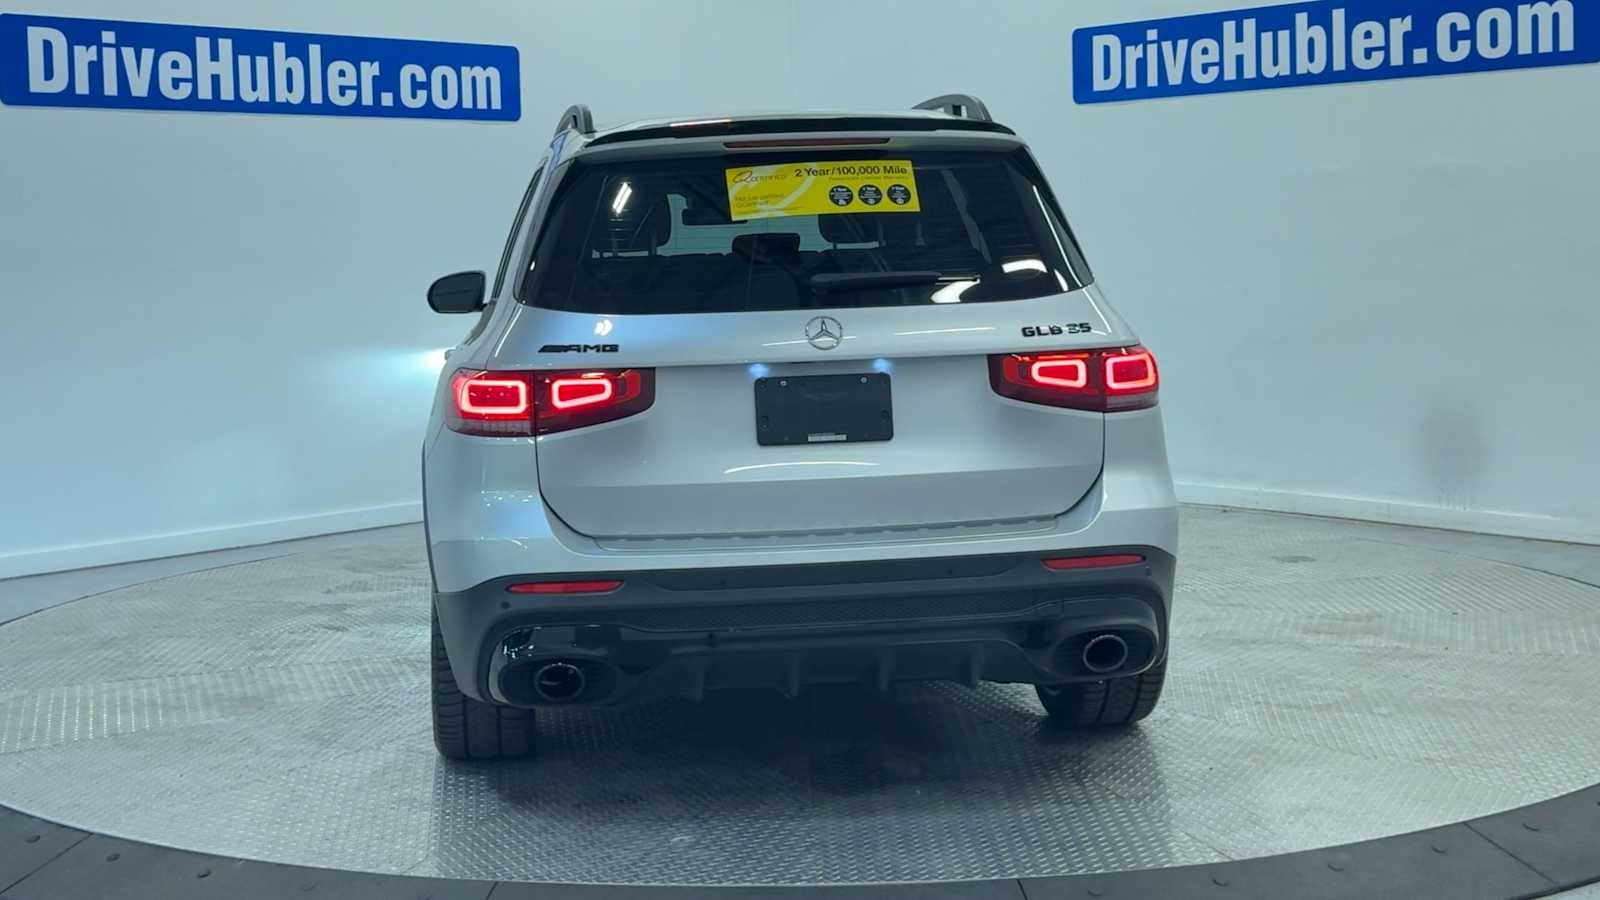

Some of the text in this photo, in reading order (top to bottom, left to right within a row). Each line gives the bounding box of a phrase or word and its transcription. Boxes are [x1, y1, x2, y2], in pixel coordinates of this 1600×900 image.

[1092, 0, 1575, 91] DriveHubler.com
[26, 25, 503, 110] DriveHubler.com
[794, 168, 803, 178] 2
[883, 165, 908, 175] Mile
[1021, 322, 1092, 338] GLB 35
[560, 343, 620, 354] AMG
